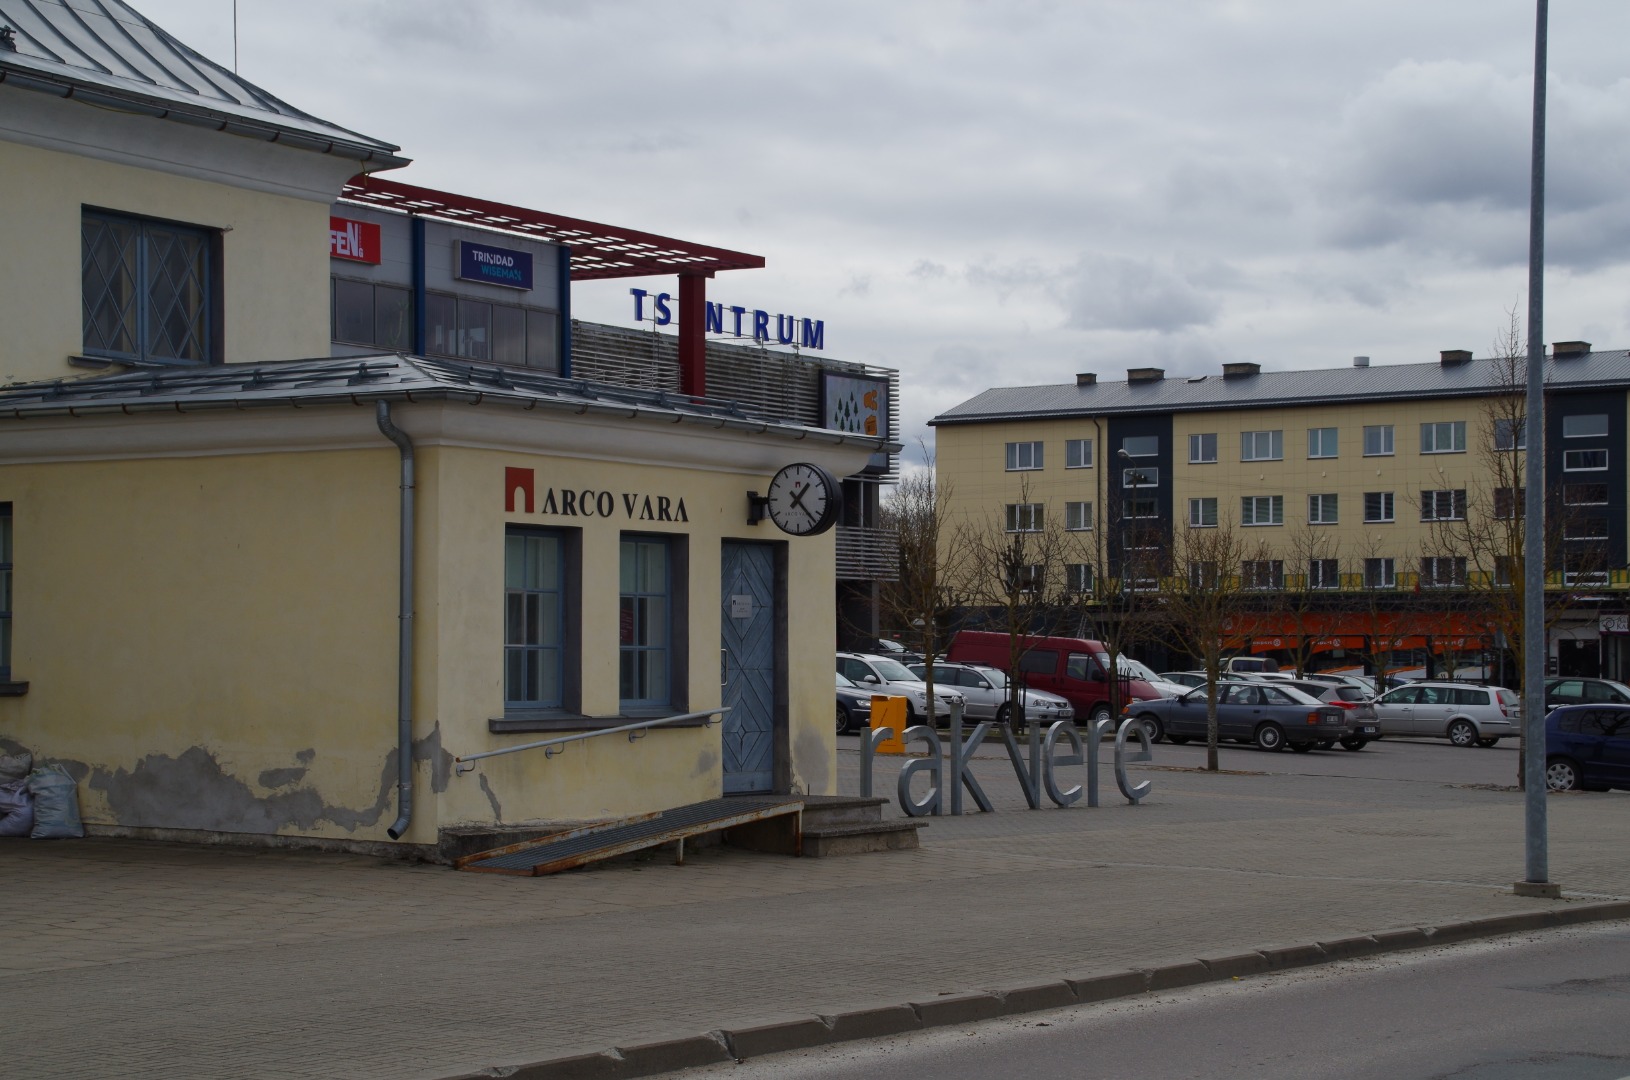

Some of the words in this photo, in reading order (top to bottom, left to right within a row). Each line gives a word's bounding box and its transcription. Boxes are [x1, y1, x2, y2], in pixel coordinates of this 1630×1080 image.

[472, 250, 514, 266] TRINIDAD
[481, 264, 522, 281] WISEMAN
[630, 288, 824, 350] TSNTRUM
[542, 487, 614, 518] ARCO
[622, 493, 689, 522] VARA
[860, 703, 1152, 817] rakvere
